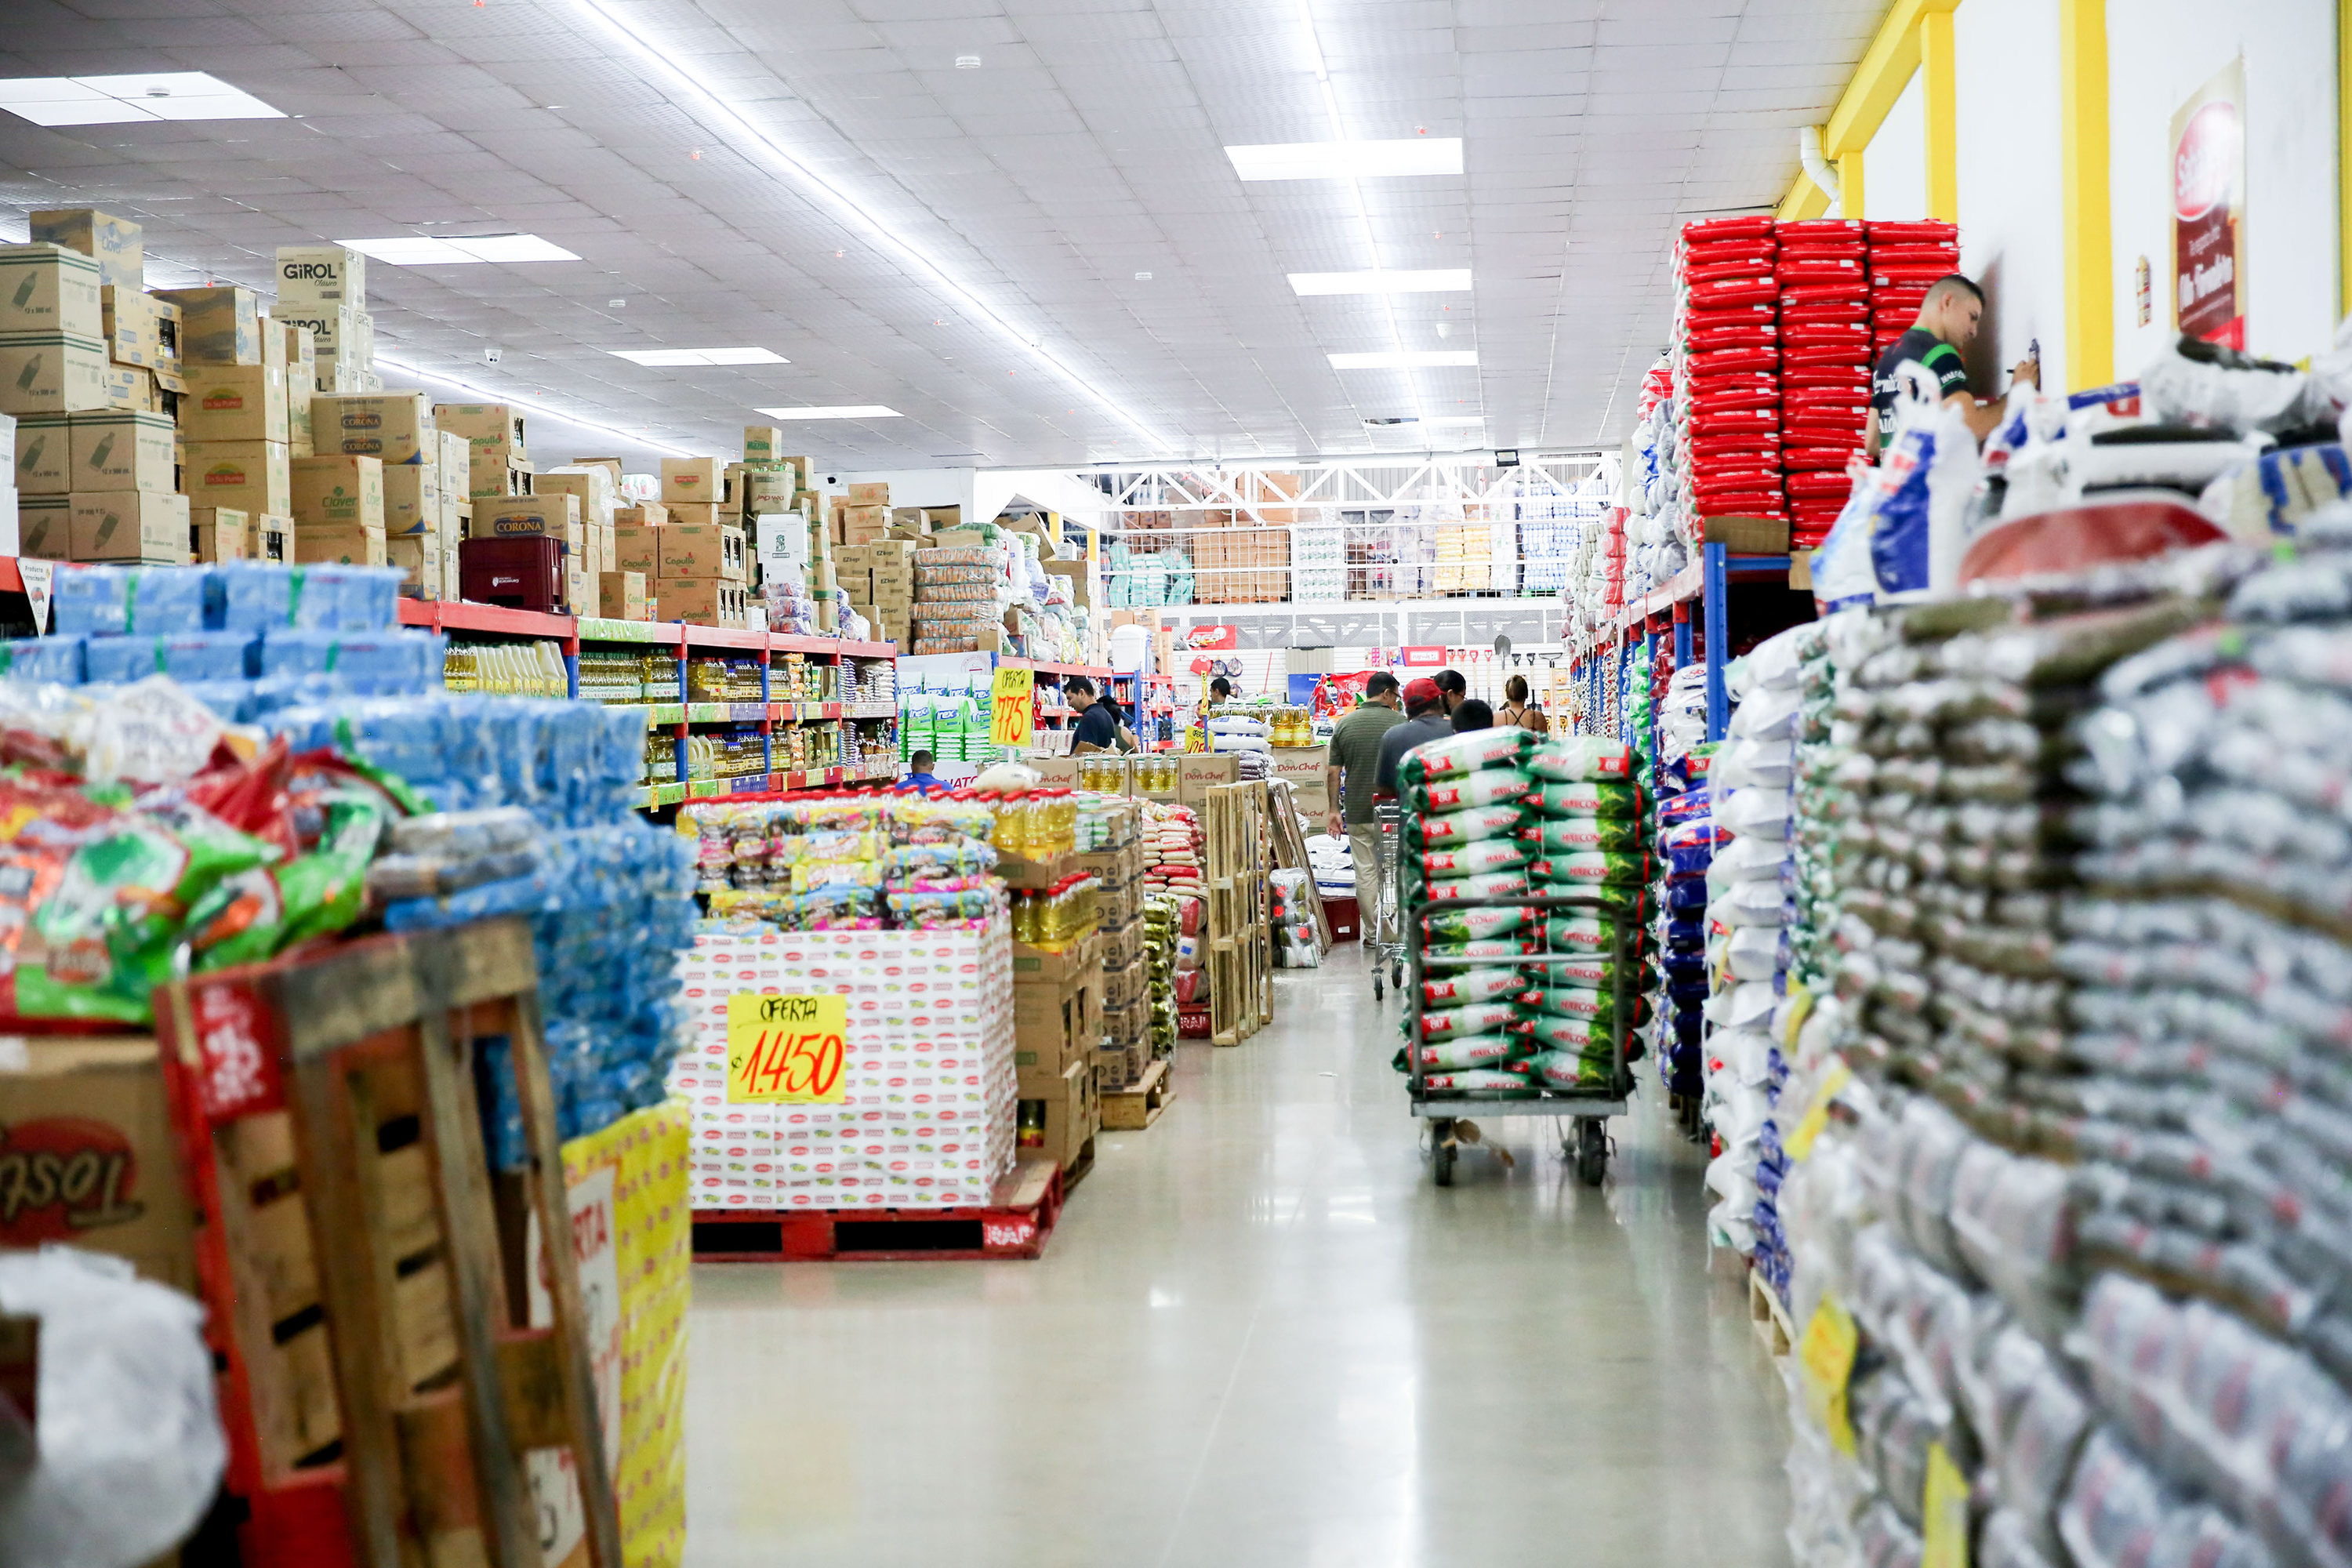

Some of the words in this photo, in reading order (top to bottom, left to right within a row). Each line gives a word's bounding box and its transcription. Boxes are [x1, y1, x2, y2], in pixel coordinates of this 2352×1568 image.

[343, 418, 379, 426] CORONA
[343, 442, 380, 451] CORONA
[470, 488, 500, 496] apullo
[322, 496, 358, 508] Clover
[496, 521, 542, 532] CORONA
[622, 559, 652, 570] Capullo
[665, 556, 695, 568] Capullo
[681, 610, 711, 622] Capullo
[973, 690, 990, 699] Irex
[909, 709, 927, 718] Irex
[935, 710, 956, 720] Irex
[1277, 764, 1299, 772] Don
[1298, 762, 1320, 771] Chef
[1430, 759, 1445, 770] 80
[1694, 760, 1705, 769] 90
[1051, 775, 1073, 784] Chef
[1205, 772, 1225, 781] Chef
[1437, 791, 1451, 802] 80
[1430, 822, 1444, 834] 80
[1432, 855, 1447, 866] 80
[1436, 888, 1450, 898] 80
[1433, 984, 1447, 996] 80
[760, 998, 818, 1022] OFERTA
[1429, 1018, 1444, 1029] 80
[740, 1030, 844, 1096] 1.450
